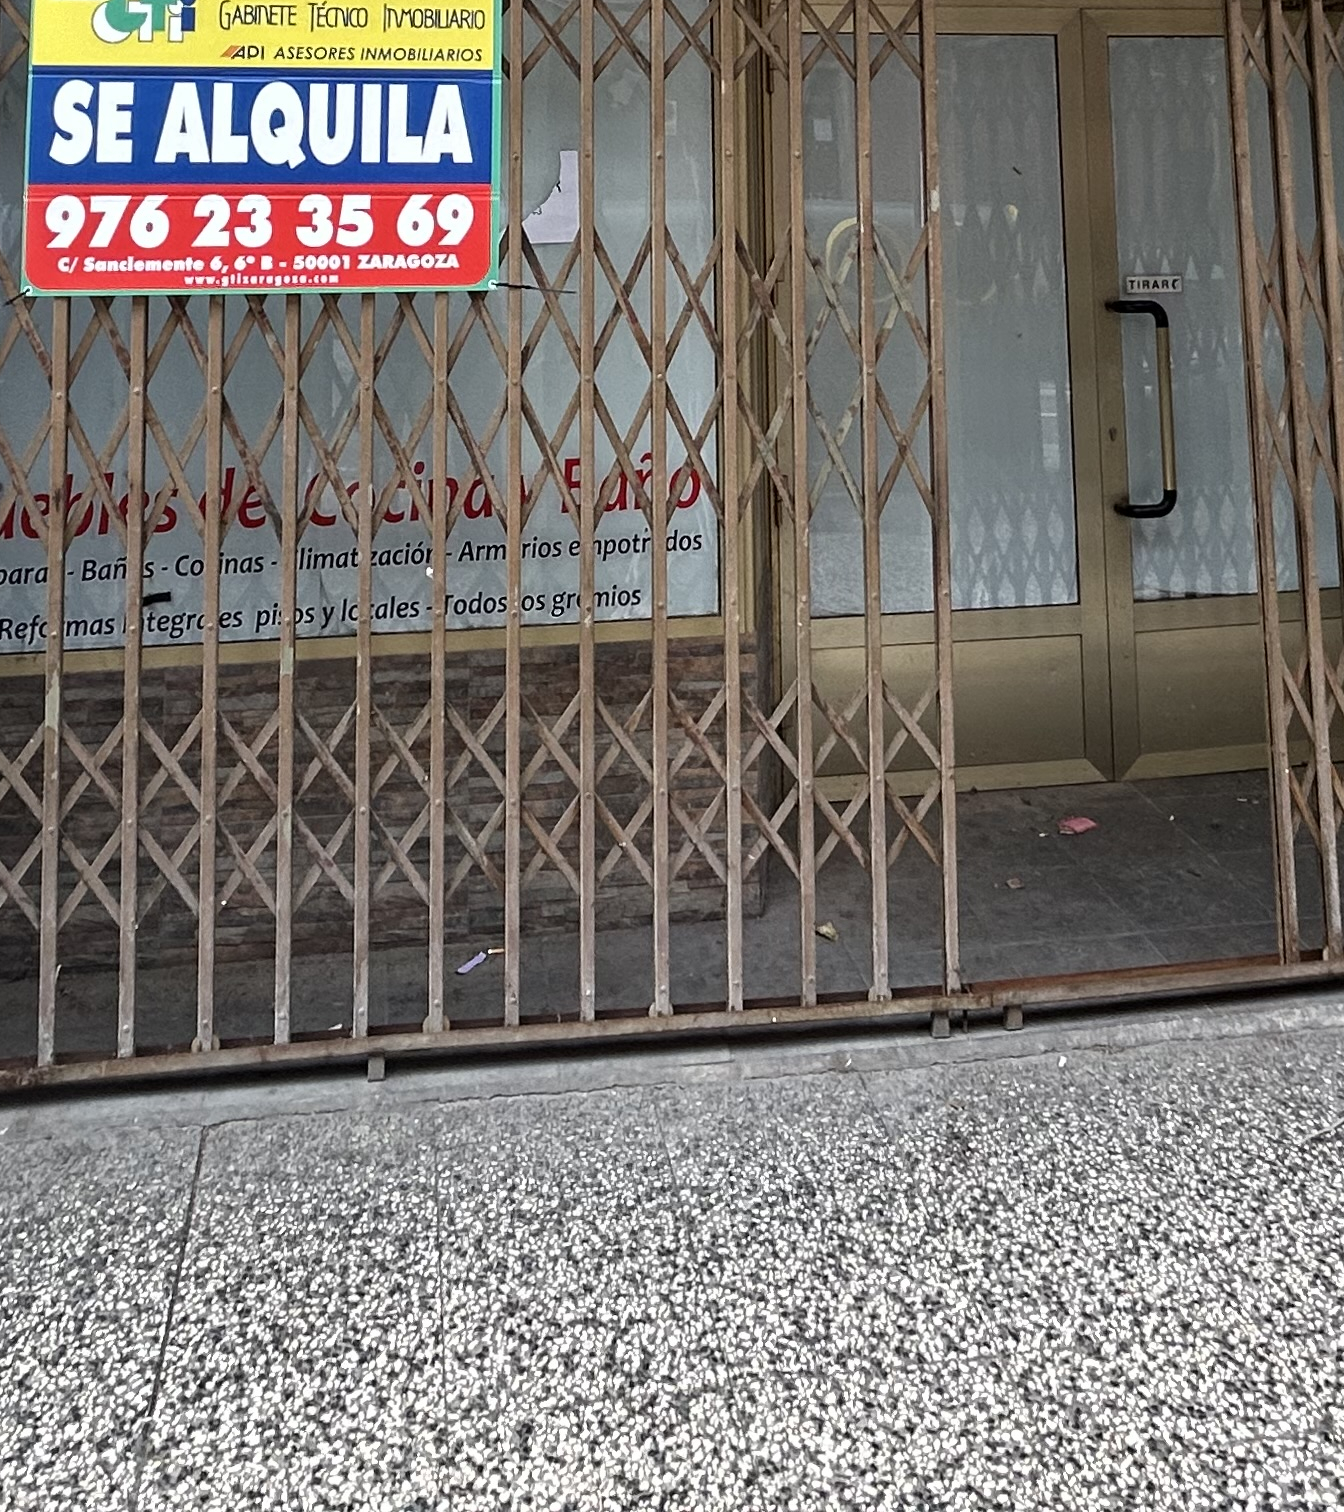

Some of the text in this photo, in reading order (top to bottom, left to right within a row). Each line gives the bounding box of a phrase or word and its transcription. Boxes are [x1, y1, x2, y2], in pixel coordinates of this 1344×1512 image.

[219, 0, 297, 30] GABINETE
[308, 0, 368, 32] TÉCNICO
[383, 2, 485, 33] INMOBILIARIO
[231, 45, 483, 62] API ASESORES INMOBILIARIOS
[48, 80, 473, 169] SE ALQUILA
[45, 194, 170, 248] 976
[191, 194, 272, 248] 23
[295, 194, 374, 247] 35
[396, 193, 475, 247] 69
[57, 256, 79, 274] C/
[83, 256, 205, 272] Sanclemente
[260, 255, 274, 270] B
[293, 254, 350, 270] 50001
[357, 253, 460, 269] ZARAGOZA
[184, 273, 339, 286] www.gtizaragoza.com
[199, 467, 267, 529] de
[82, 555, 154, 581] Bañs
[176, 552, 264, 576] Coinas
[294, 541, 435, 570] limatzació
[458, 536, 562, 562] Armrios
[569, 529, 702, 561] epotrdos
[121, 610, 243, 639] Itegraes
[321, 605, 335, 630] y
[517, 590, 546, 612] os
